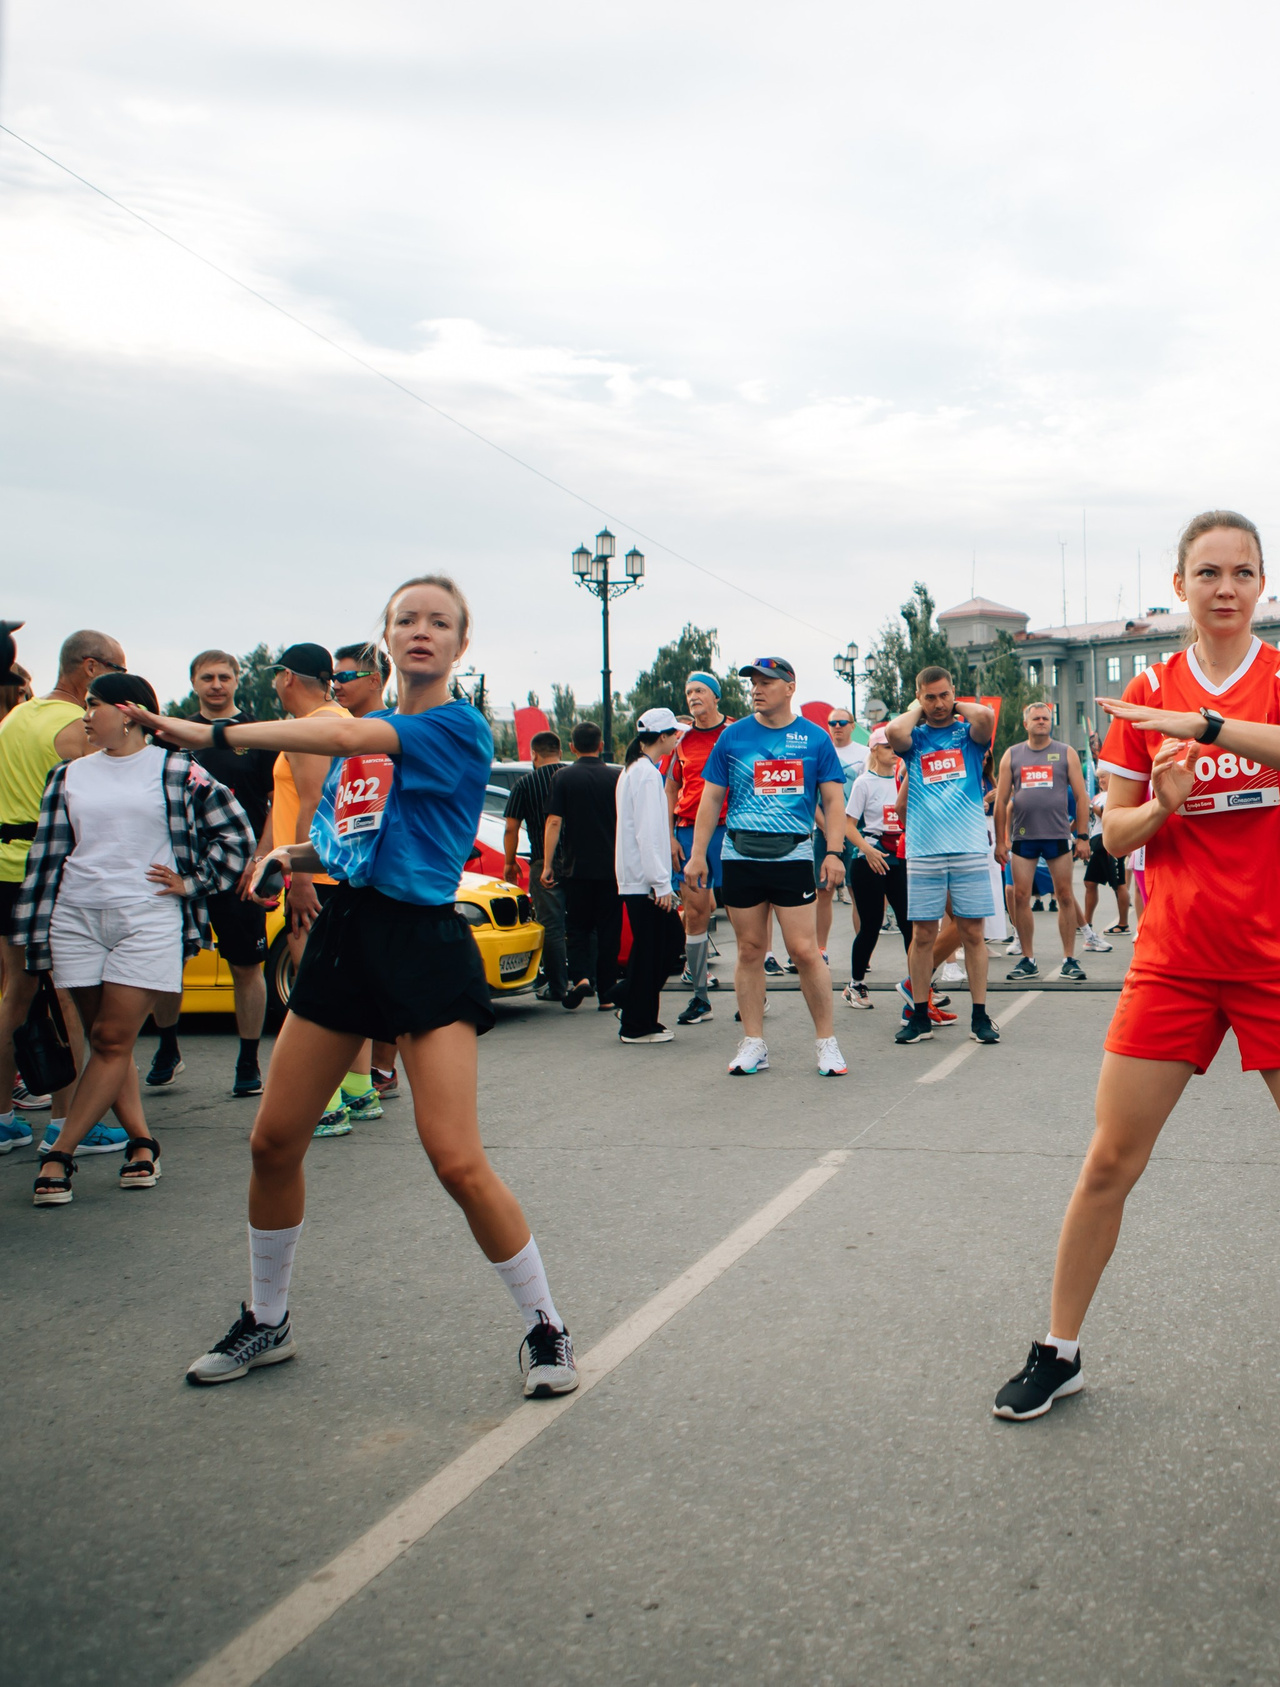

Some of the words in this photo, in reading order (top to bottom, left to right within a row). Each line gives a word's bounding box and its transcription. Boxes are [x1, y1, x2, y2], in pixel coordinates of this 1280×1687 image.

[928, 757, 956, 772] 1861
[1177, 753, 1261, 781] 080
[762, 769, 796, 782] 2491
[1026, 771, 1048, 780] 2186
[338, 777, 380, 809] 2422
[887, 811, 899, 821] 29
